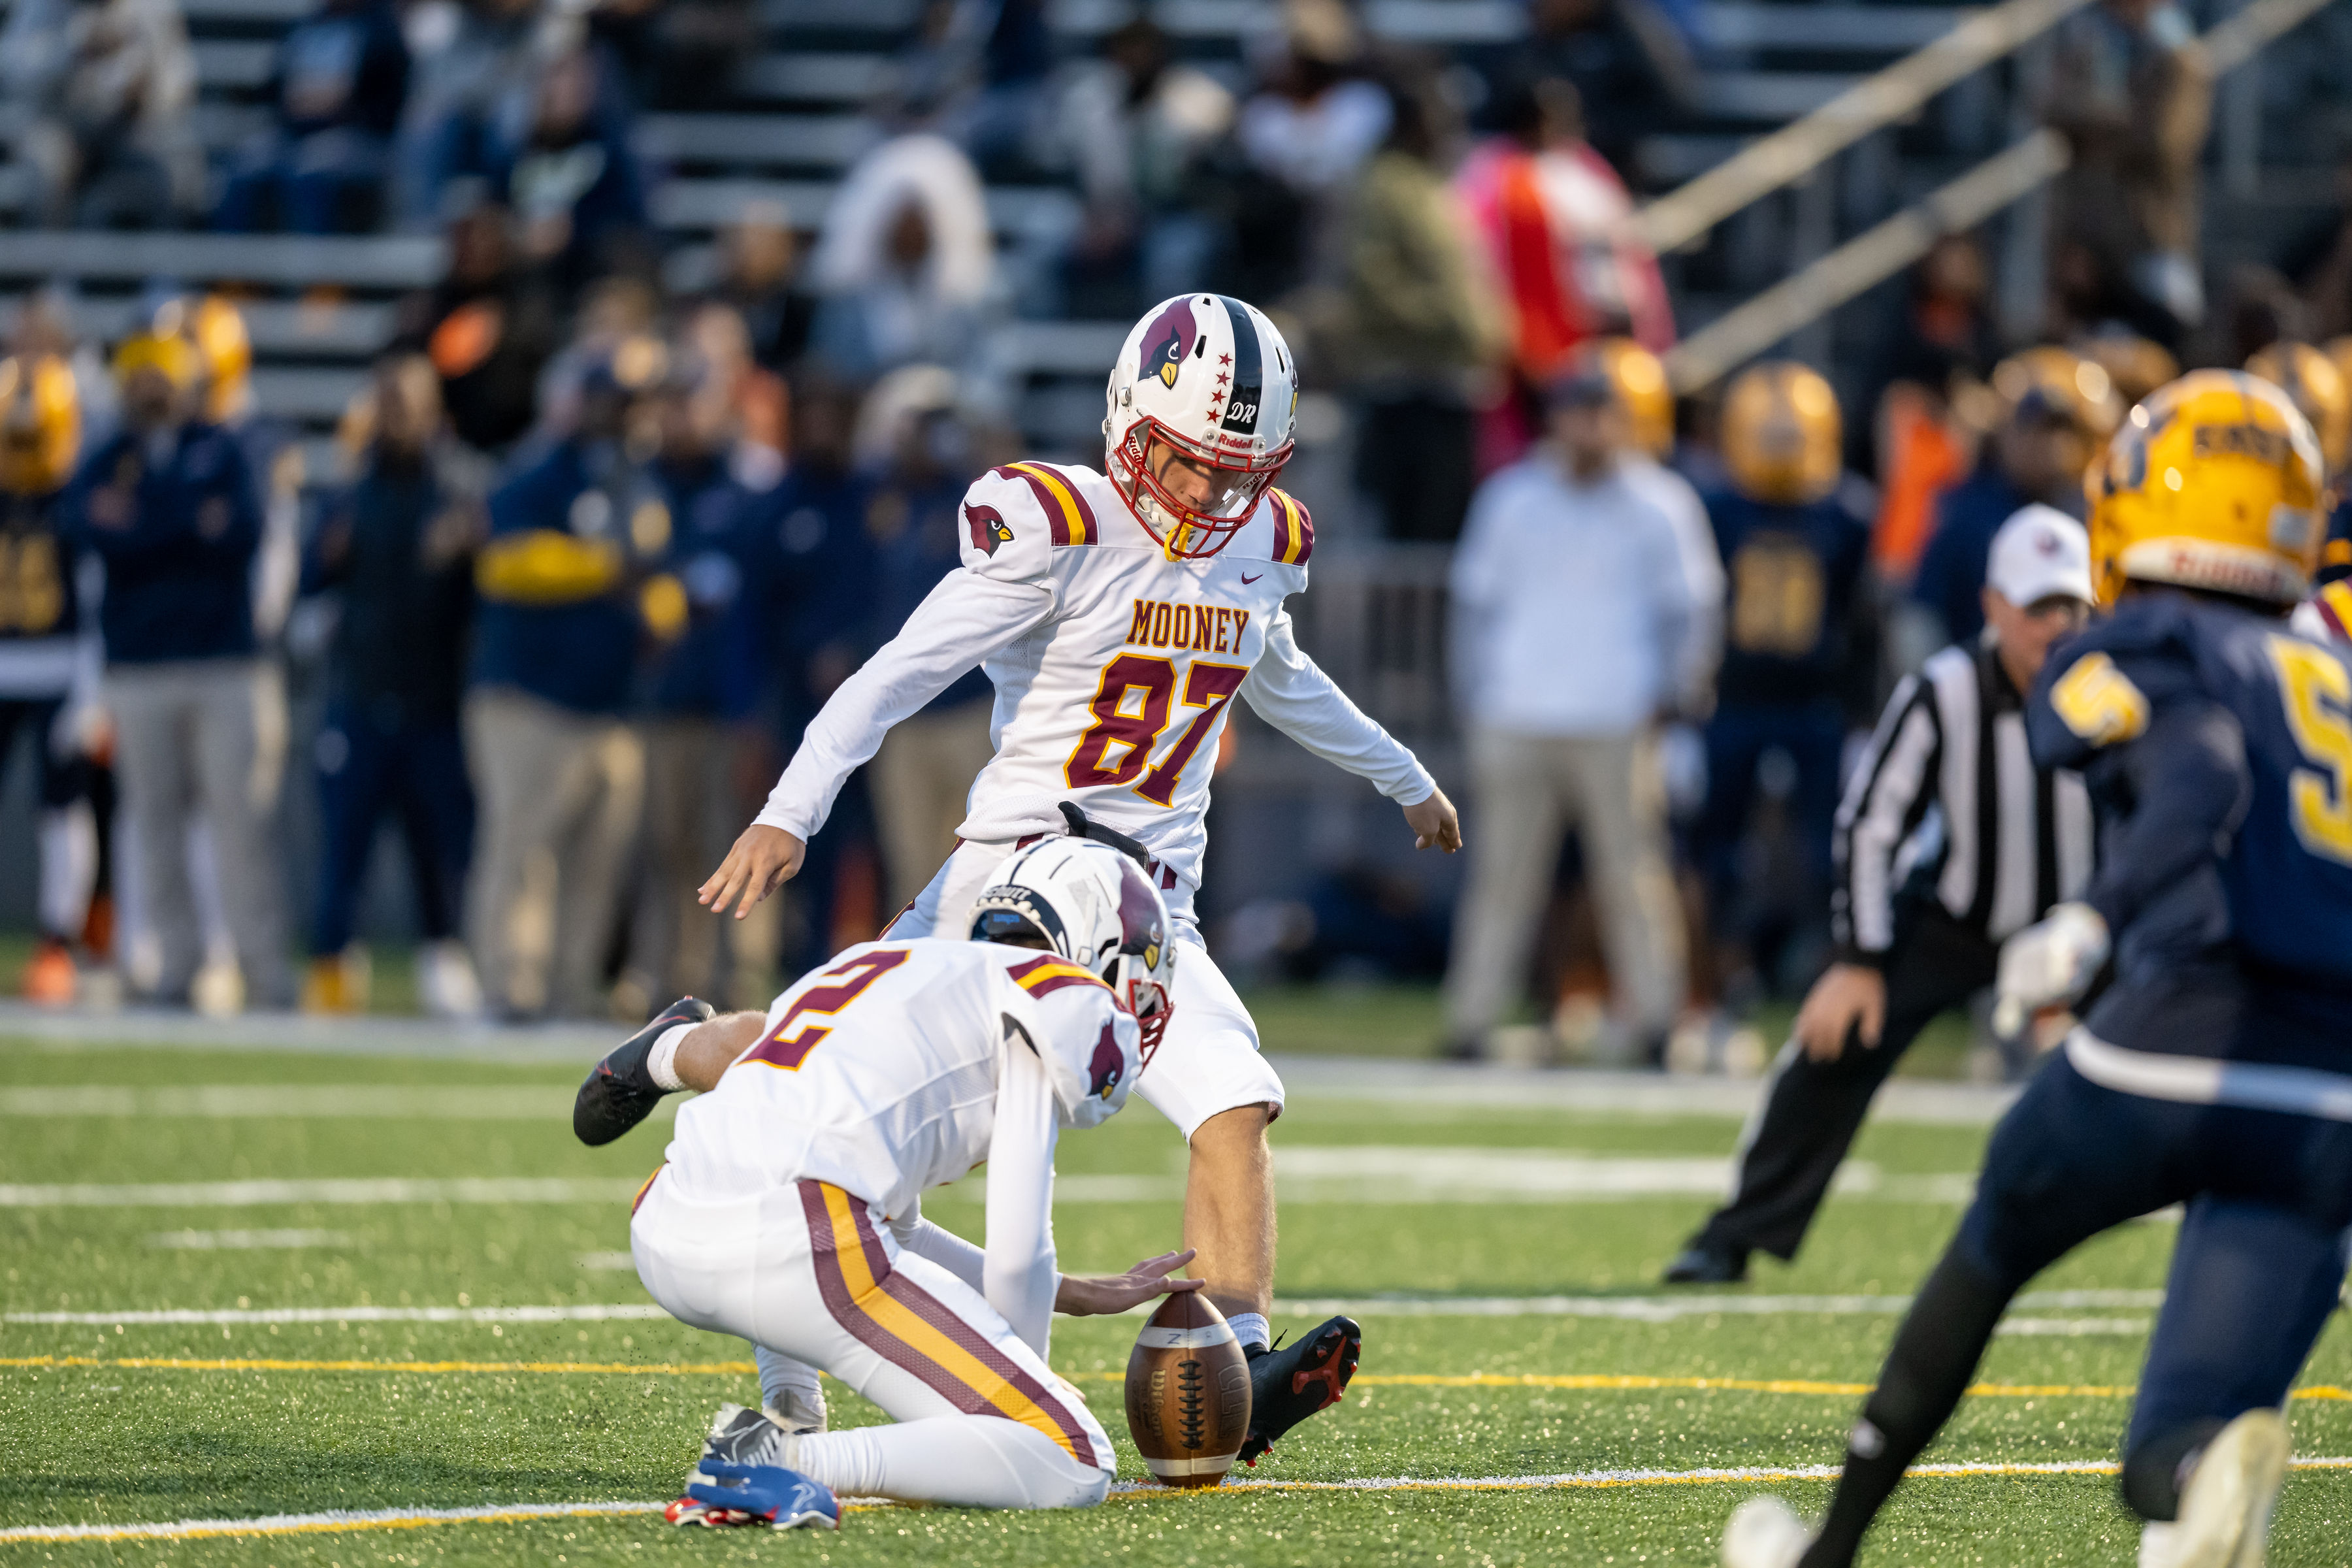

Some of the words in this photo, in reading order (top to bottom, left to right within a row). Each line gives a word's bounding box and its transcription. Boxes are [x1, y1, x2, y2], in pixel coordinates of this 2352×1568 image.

[1218, 433, 1254, 449] Riddell
[1126, 598, 1249, 655] MOONEY
[1064, 651, 1250, 808] 87
[733, 949, 911, 1071] 2
